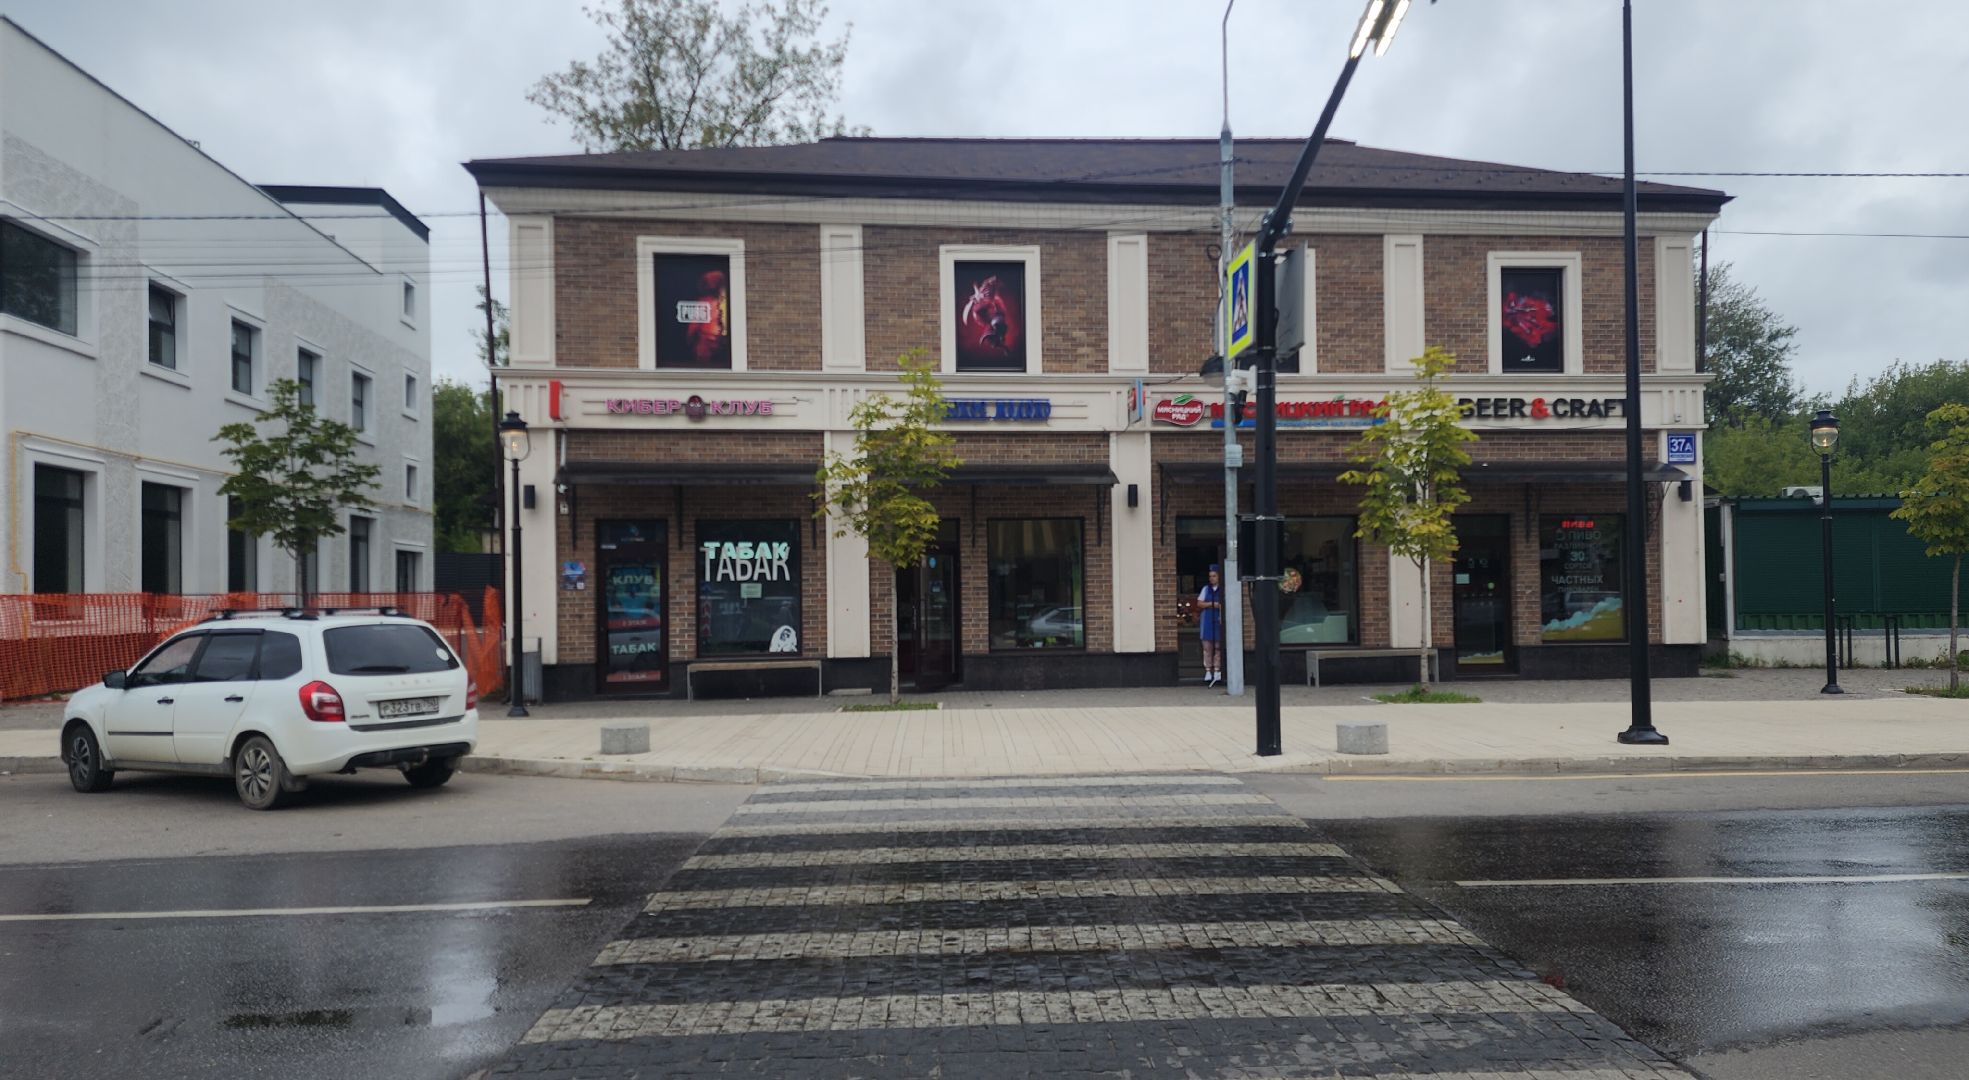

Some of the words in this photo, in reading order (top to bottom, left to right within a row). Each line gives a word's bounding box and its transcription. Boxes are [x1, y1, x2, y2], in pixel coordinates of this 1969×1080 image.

[606, 399, 682, 415] КИБЕР
[710, 400, 774, 416] КЛУБ
[704, 541, 788, 560] ТАБАК
[1570, 551, 1585, 561] 30
[1551, 575, 1604, 585] ЧАСТНЫХ
[612, 642, 657, 655] ТАБАК
